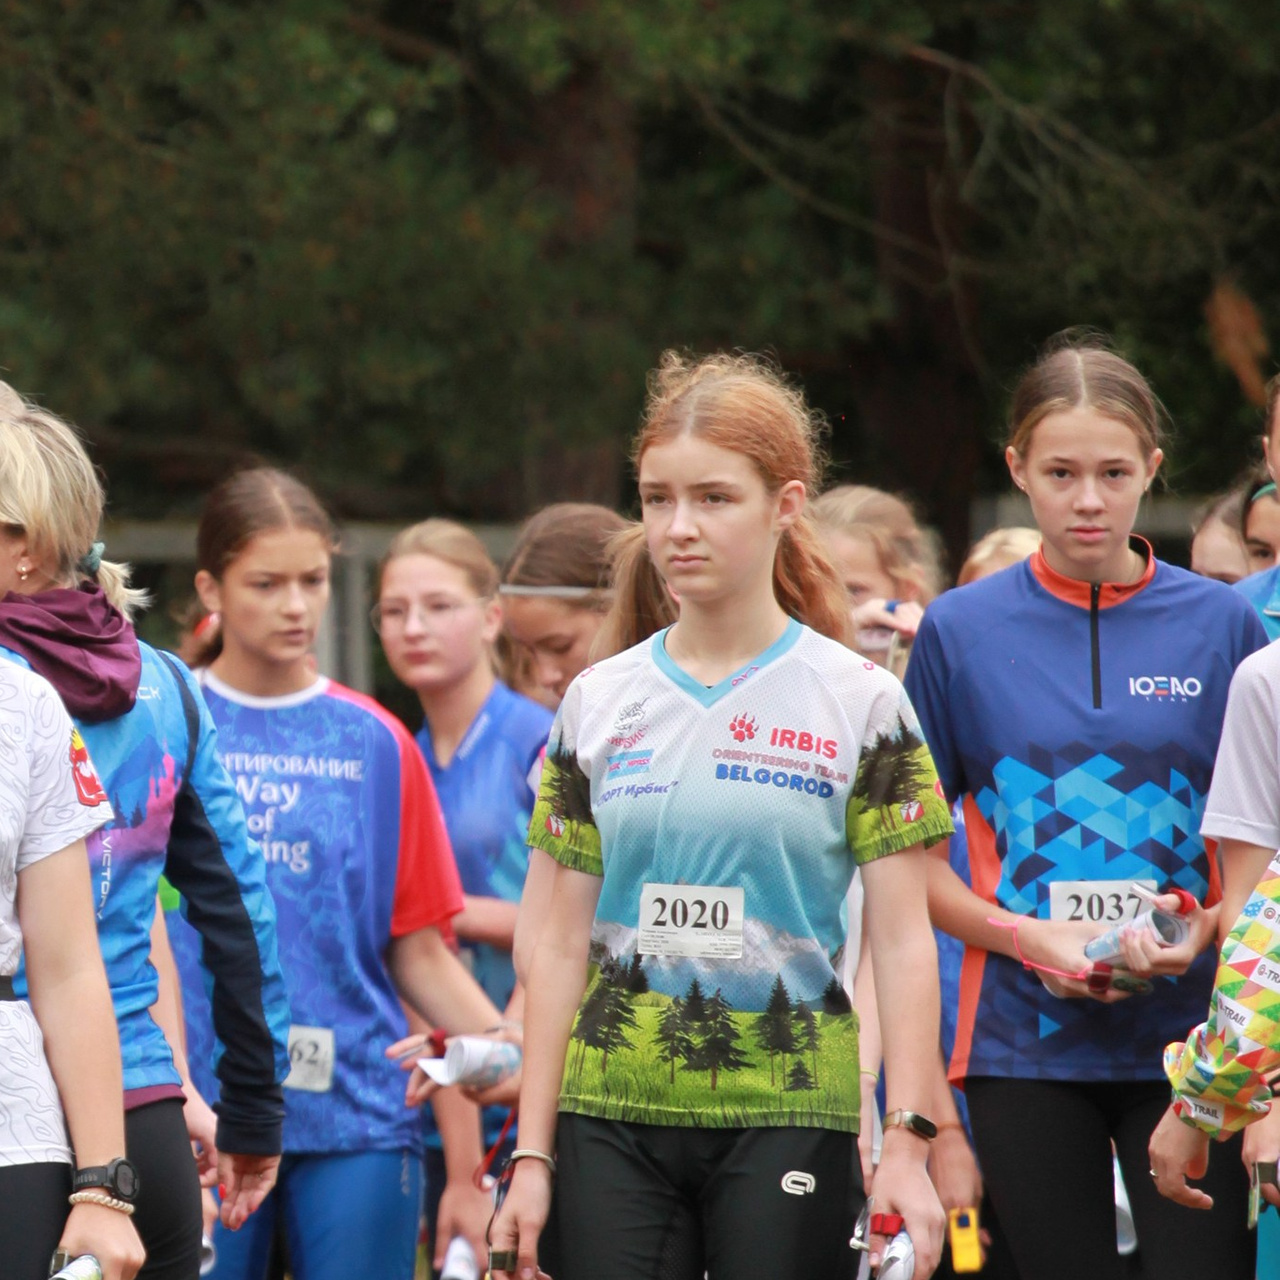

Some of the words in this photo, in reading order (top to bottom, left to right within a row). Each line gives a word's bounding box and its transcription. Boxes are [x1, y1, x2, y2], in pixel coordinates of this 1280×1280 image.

[135, 686, 162, 700] CK
[770, 727, 838, 760] IRBIS
[712, 748, 810, 772] ORIENTEERING
[814, 763, 849, 784] TEAM
[715, 763, 834, 798] BELGOROD
[246, 806, 276, 834] of
[258, 832, 310, 874] ing
[652, 897, 729, 930] 2020
[1067, 893, 1142, 921] 2037
